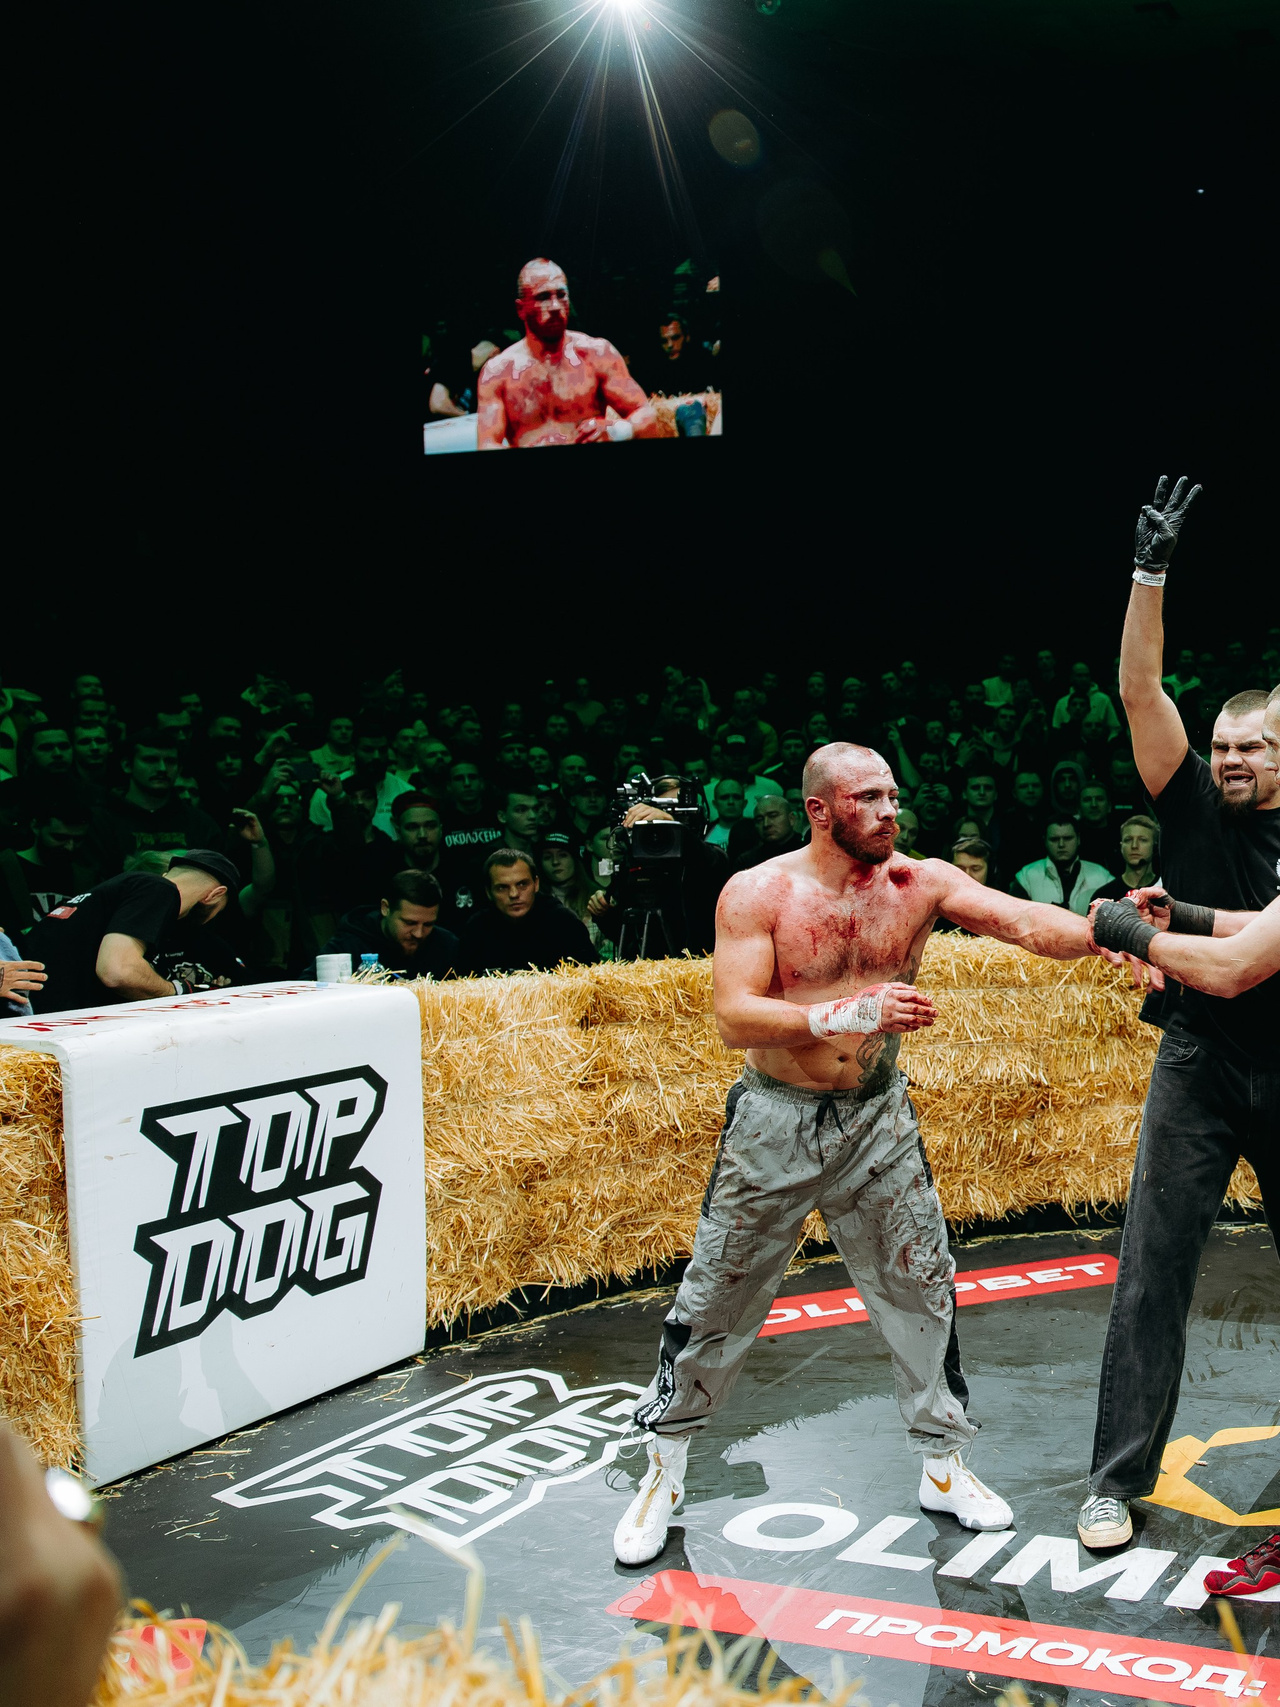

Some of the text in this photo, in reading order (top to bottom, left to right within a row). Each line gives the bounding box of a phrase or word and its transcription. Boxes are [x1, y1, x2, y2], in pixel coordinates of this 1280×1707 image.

[155, 1077, 378, 1214] TOP
[149, 1180, 371, 1338] DOG
[262, 1379, 539, 1490] TOP
[814, 1607, 1267, 1698] ПРОМОКОД:
